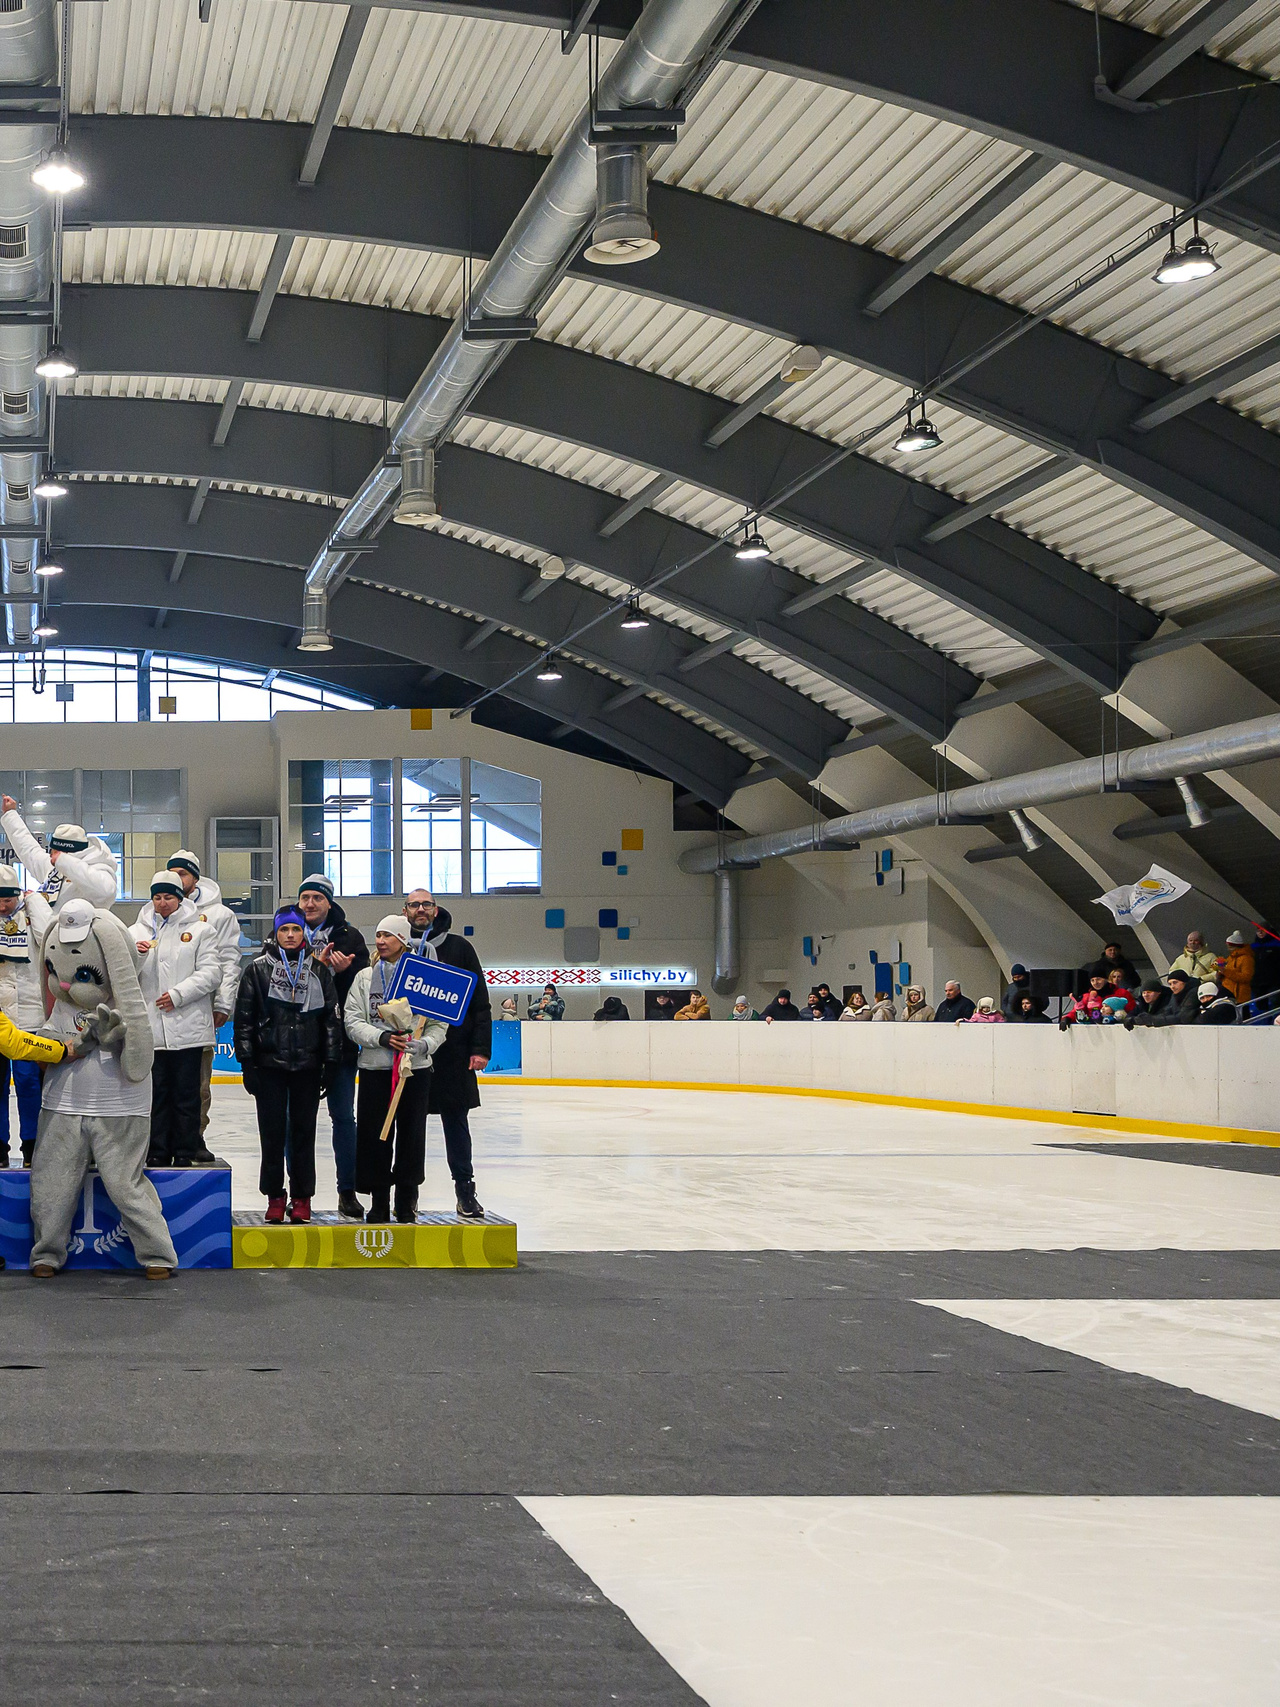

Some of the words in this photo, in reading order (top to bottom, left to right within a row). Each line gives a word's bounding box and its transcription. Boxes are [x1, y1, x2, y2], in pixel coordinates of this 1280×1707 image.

[610, 969, 688, 983] silichy.by
[404, 974, 459, 1004] Единые
[23, 1037, 53, 1051] BELARUS
[361, 1229, 388, 1248] III
